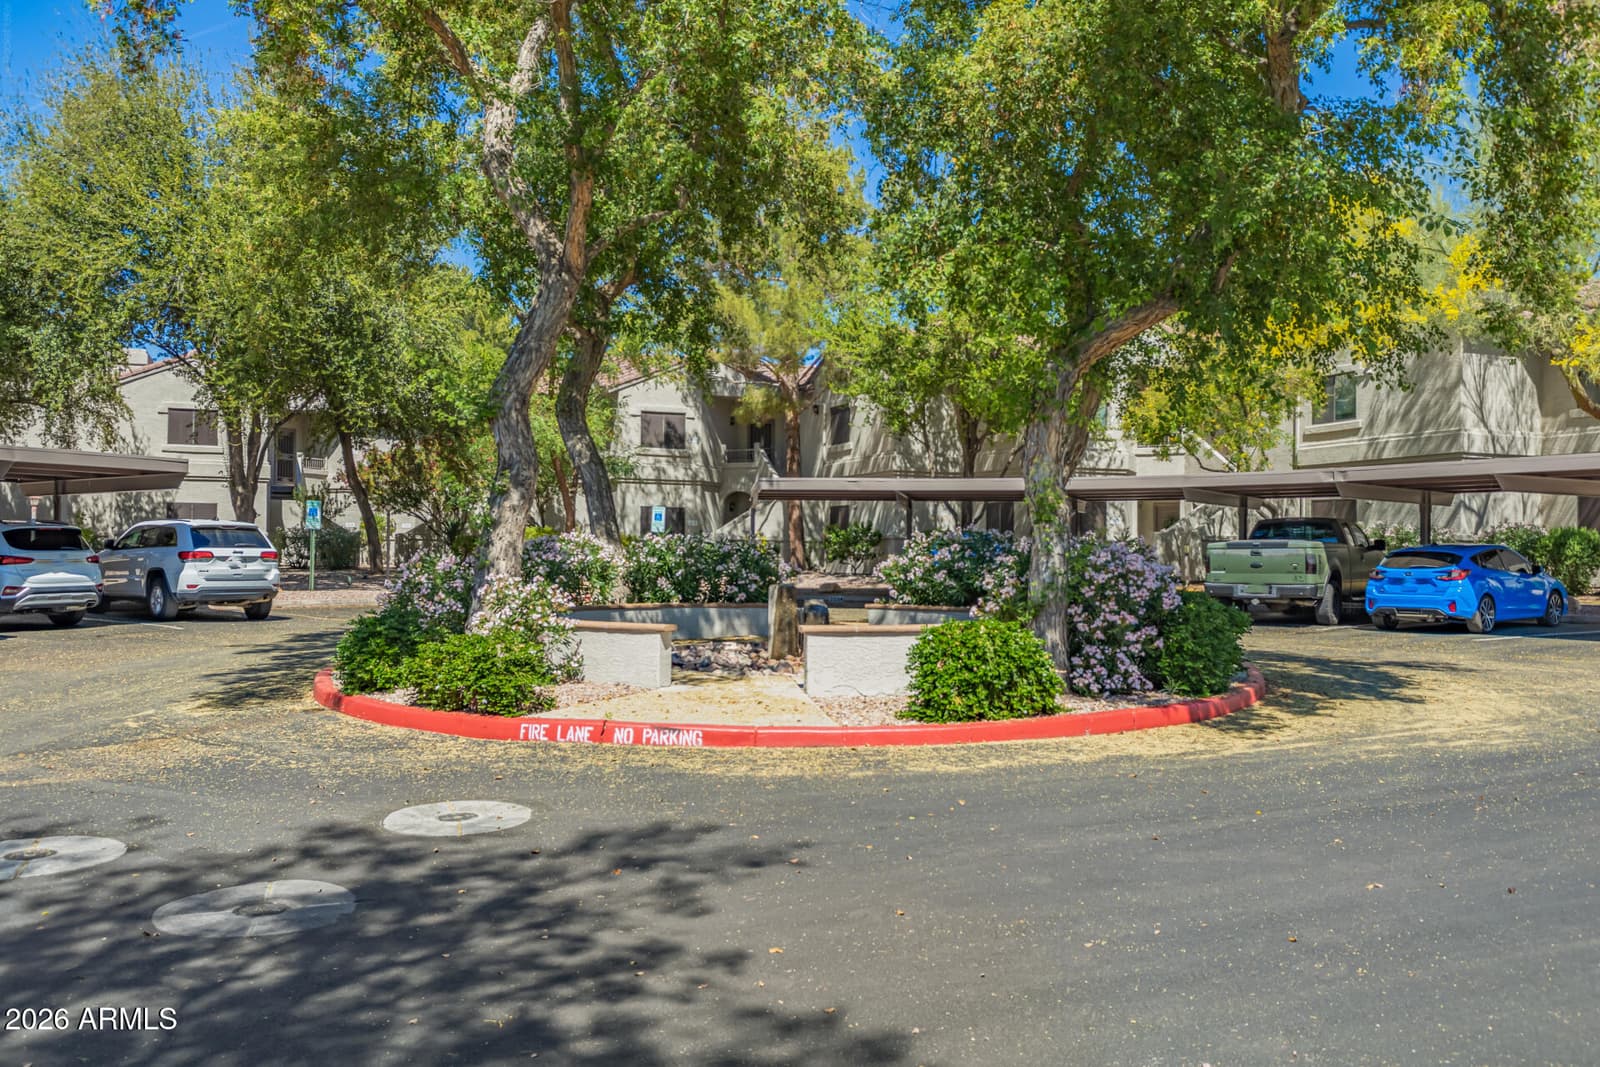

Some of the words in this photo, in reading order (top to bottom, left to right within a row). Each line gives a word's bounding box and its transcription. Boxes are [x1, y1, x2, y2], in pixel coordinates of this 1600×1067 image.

[519, 723, 549, 740] FIRE
[556, 725, 594, 742] LANE
[613, 728, 634, 744] NO
[642, 728, 703, 746] PARKING
